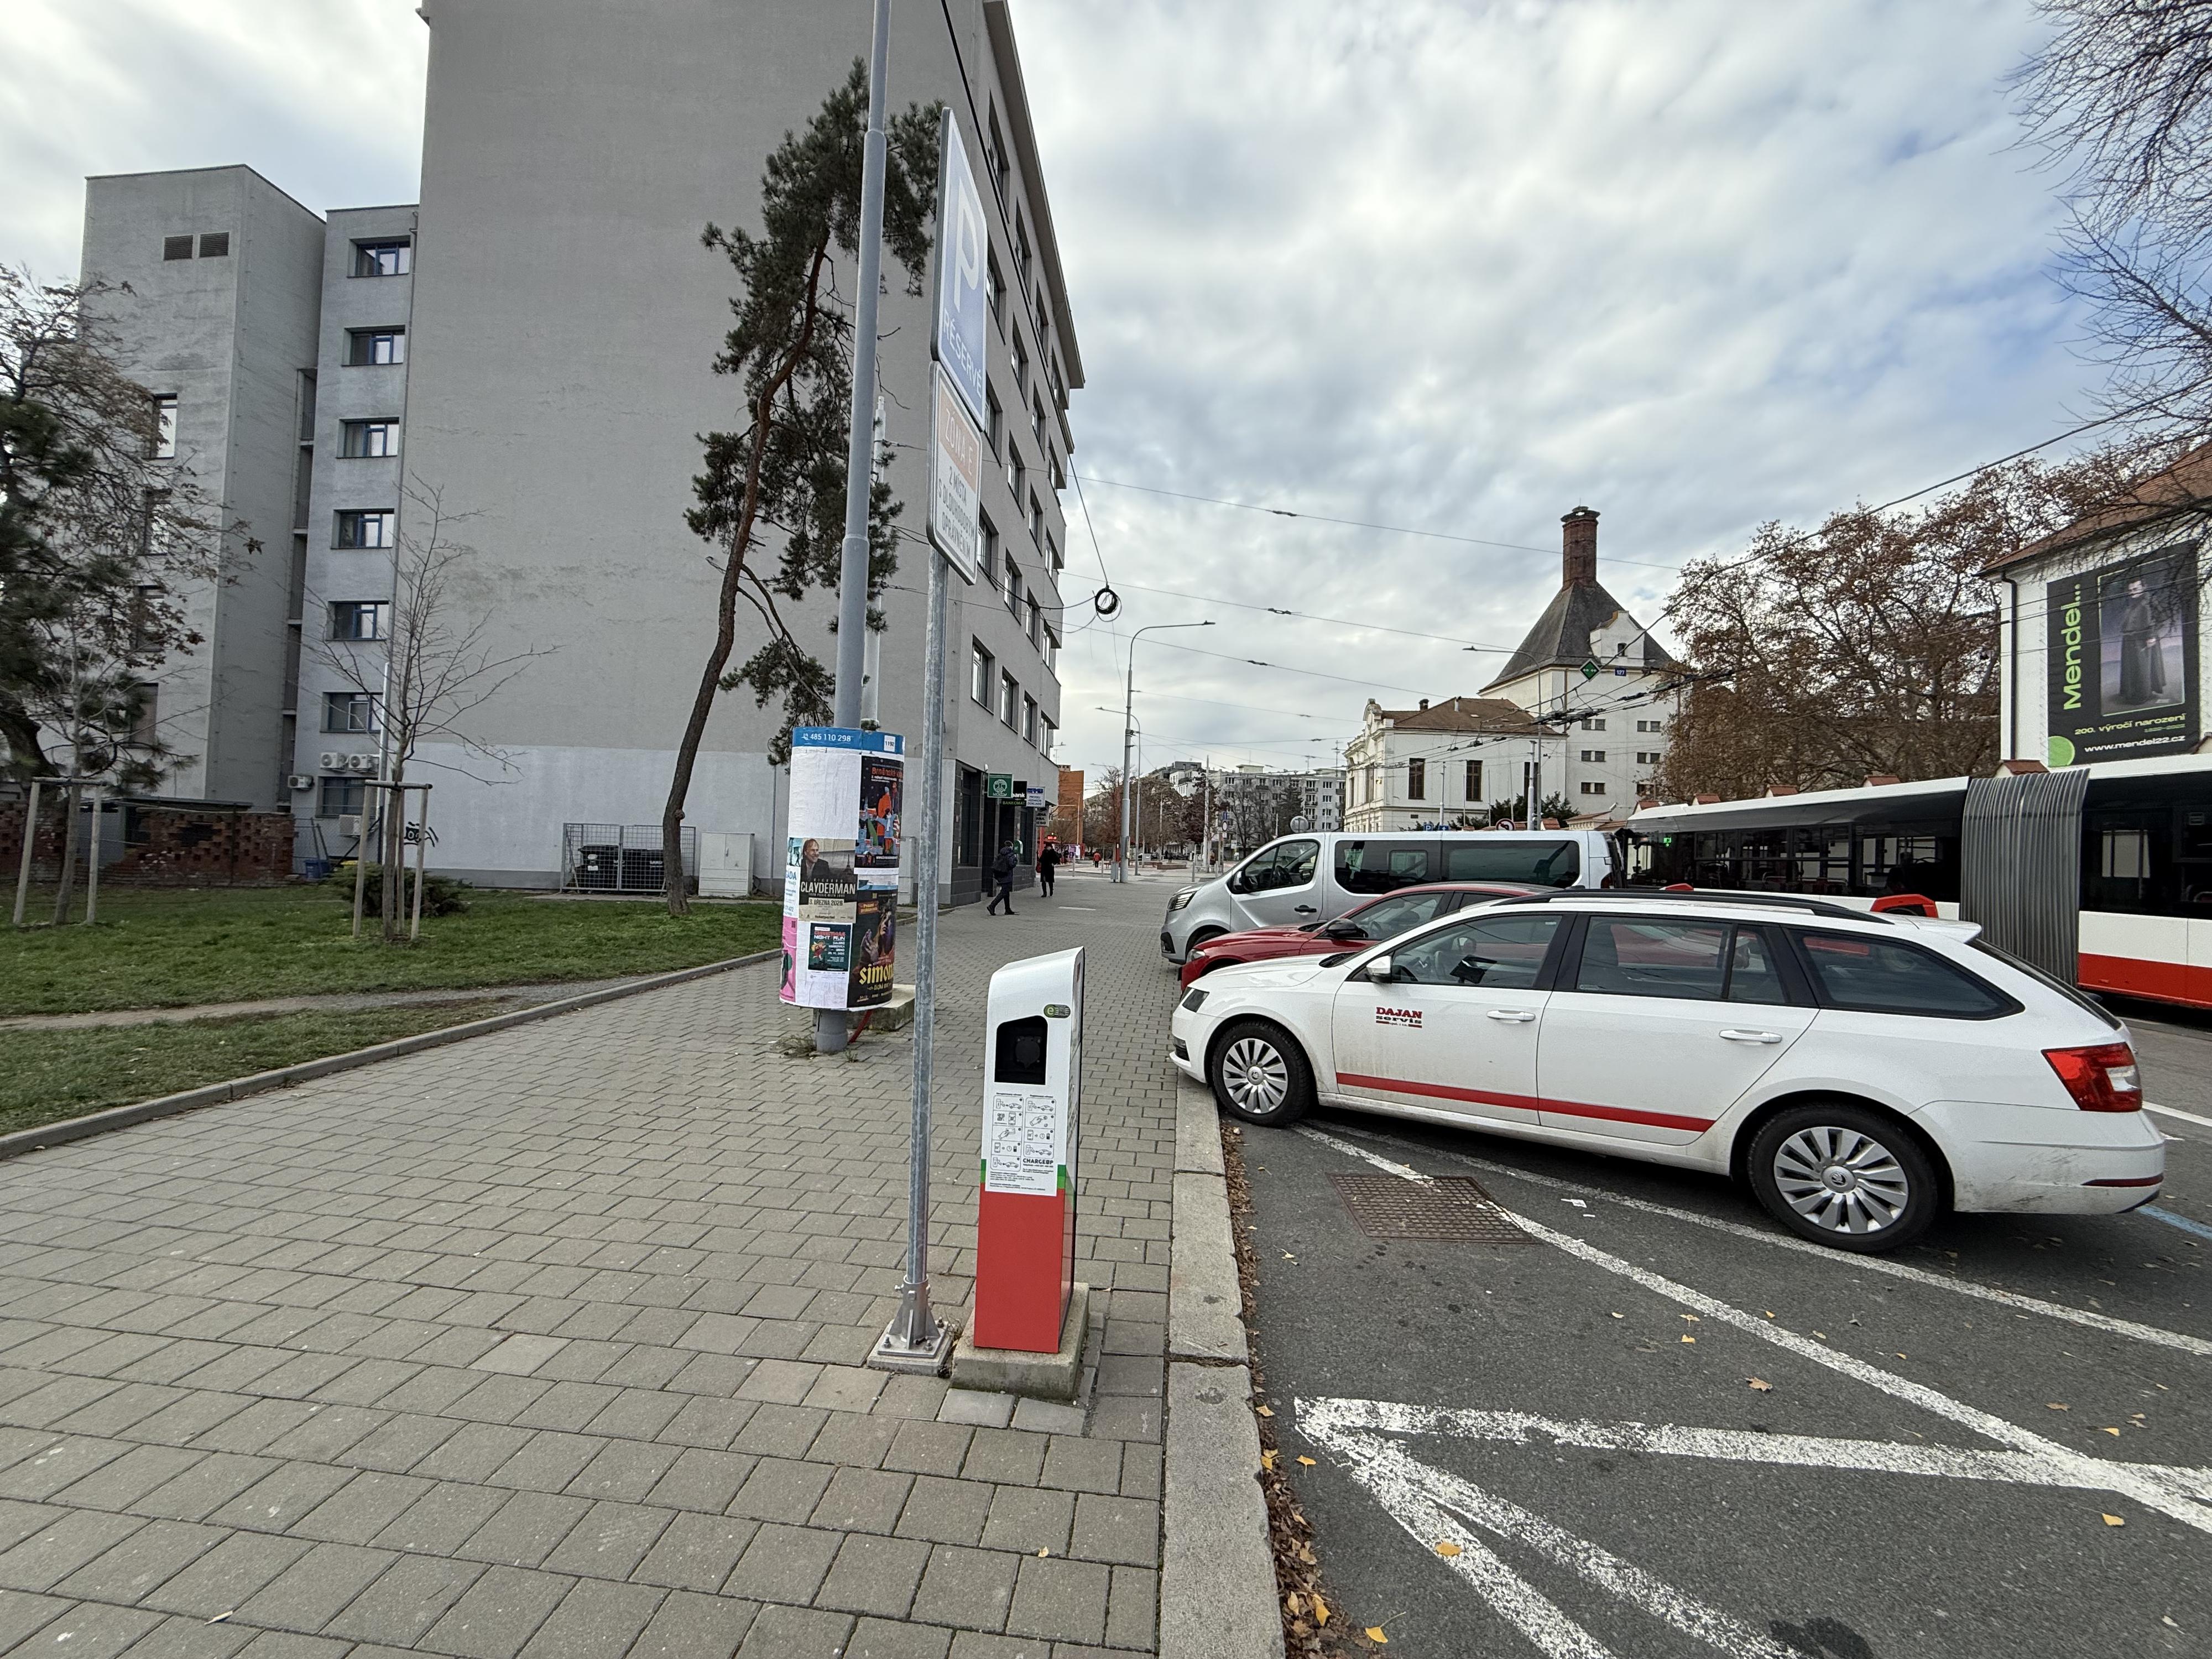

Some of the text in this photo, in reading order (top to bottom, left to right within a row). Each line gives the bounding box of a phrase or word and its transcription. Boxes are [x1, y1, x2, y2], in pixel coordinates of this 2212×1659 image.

[954, 175, 979, 314] P
[943, 307, 982, 399] RÉSERVÉ
[945, 408, 973, 476] ZÓNA E
[938, 478, 942, 498] S
[949, 466, 967, 507] 2 MÍSTA
[2060, 583, 2081, 710] Mendel...
[2074, 727, 2096, 735] 200.
[2099, 720, 2133, 733] výročí
[2135, 713, 2187, 727] narození
[2084, 735, 2186, 753] www.mendel22.cz
[801, 881, 855, 894] CLAYDERMAN
[1376, 1007, 1422, 1019] DAJAN
